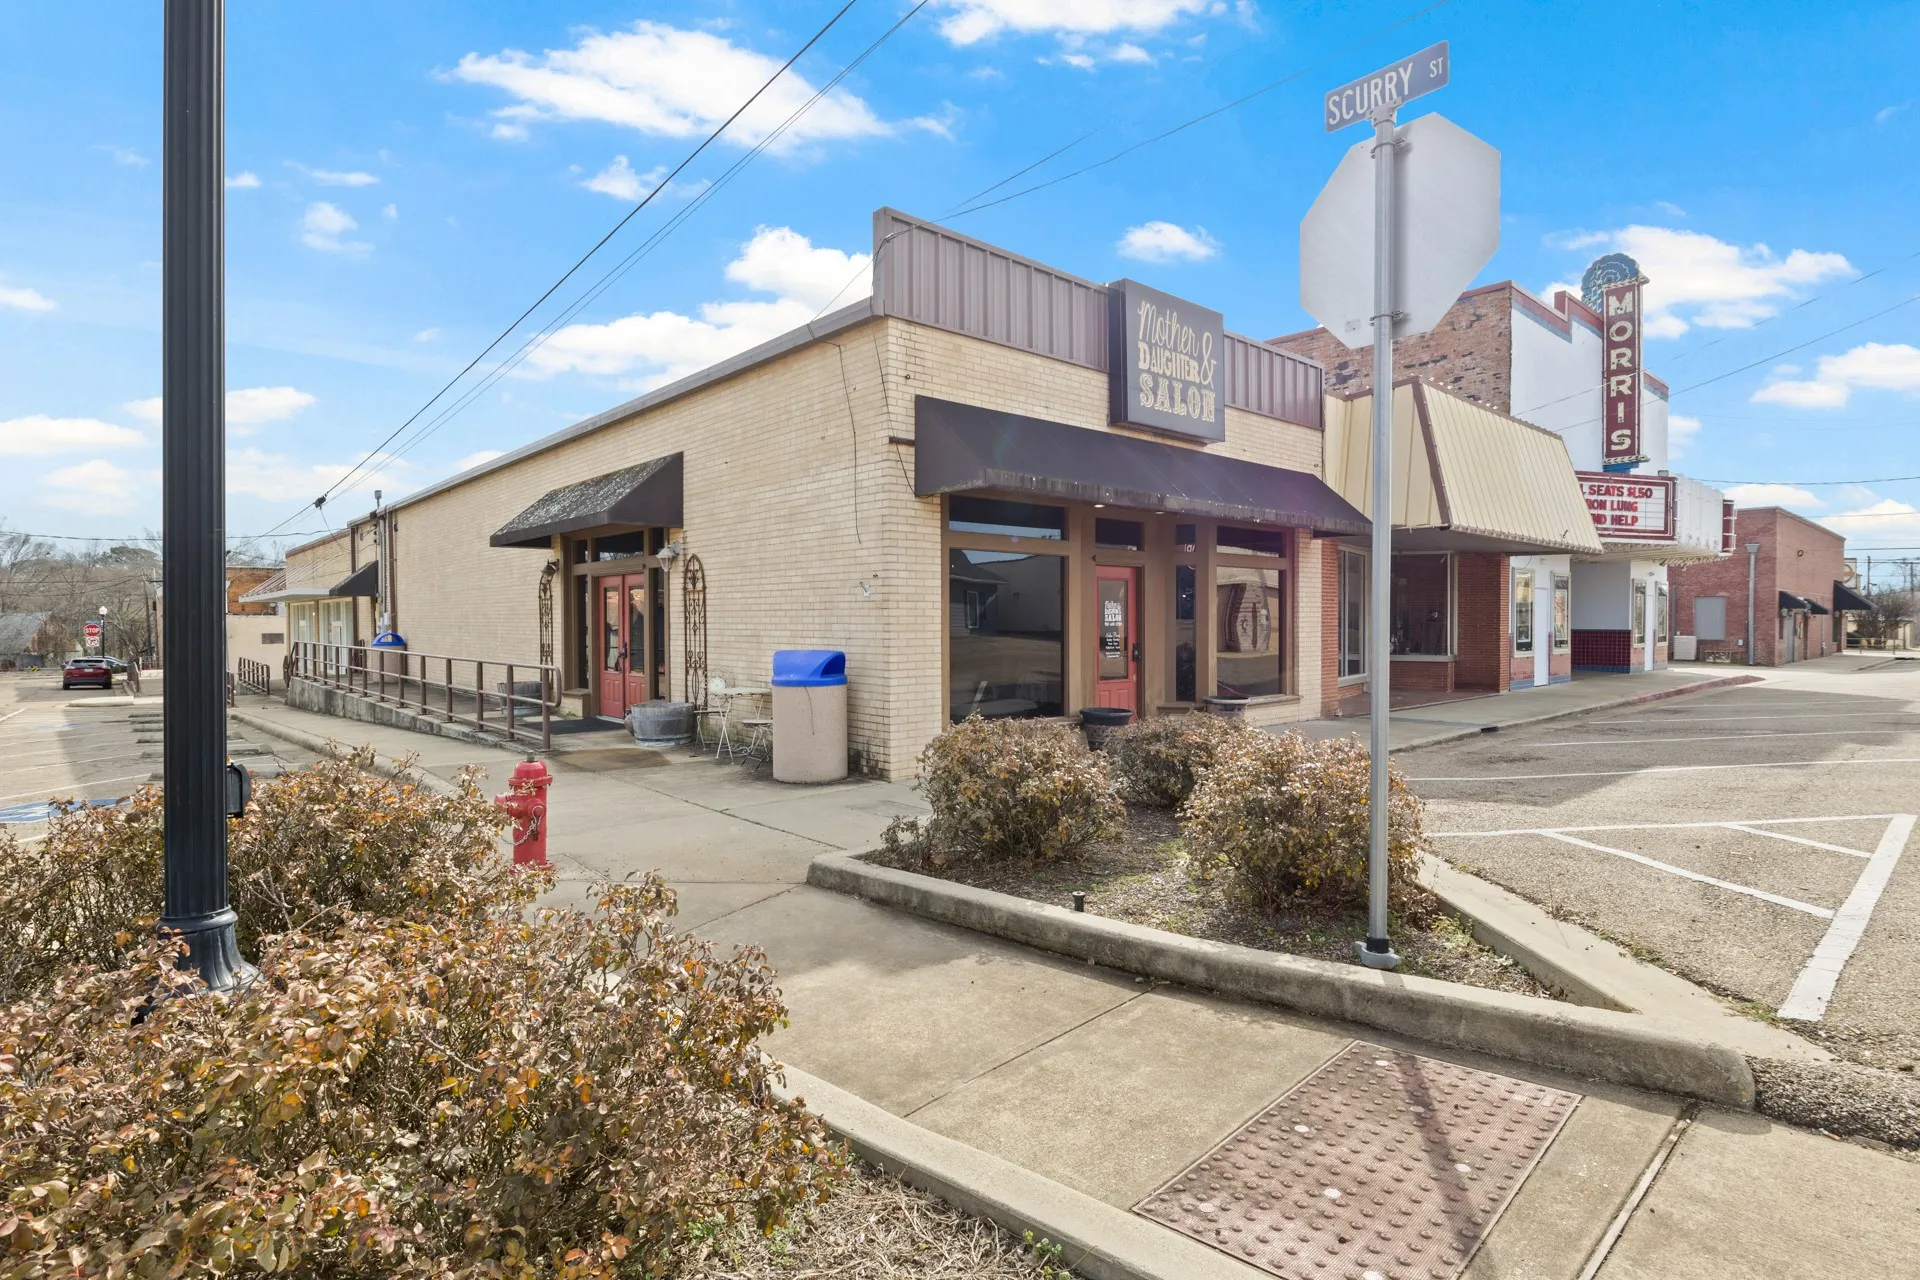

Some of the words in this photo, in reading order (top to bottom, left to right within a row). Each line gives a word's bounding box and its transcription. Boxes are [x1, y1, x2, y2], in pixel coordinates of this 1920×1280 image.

[1328, 62, 1413, 125] SCURRY
[1429, 57, 1443, 78] ST
[1137, 301, 1199, 357] Mother
[1201, 332, 1217, 389] &
[1138, 341, 1200, 384] DAUGHTER
[1609, 291, 1634, 451] MORRIS
[1140, 374, 1216, 422] SALON
[1588, 484, 1624, 496] SEATS
[1610, 500, 1638, 512] LUNG
[1610, 514, 1638, 526] HELP
